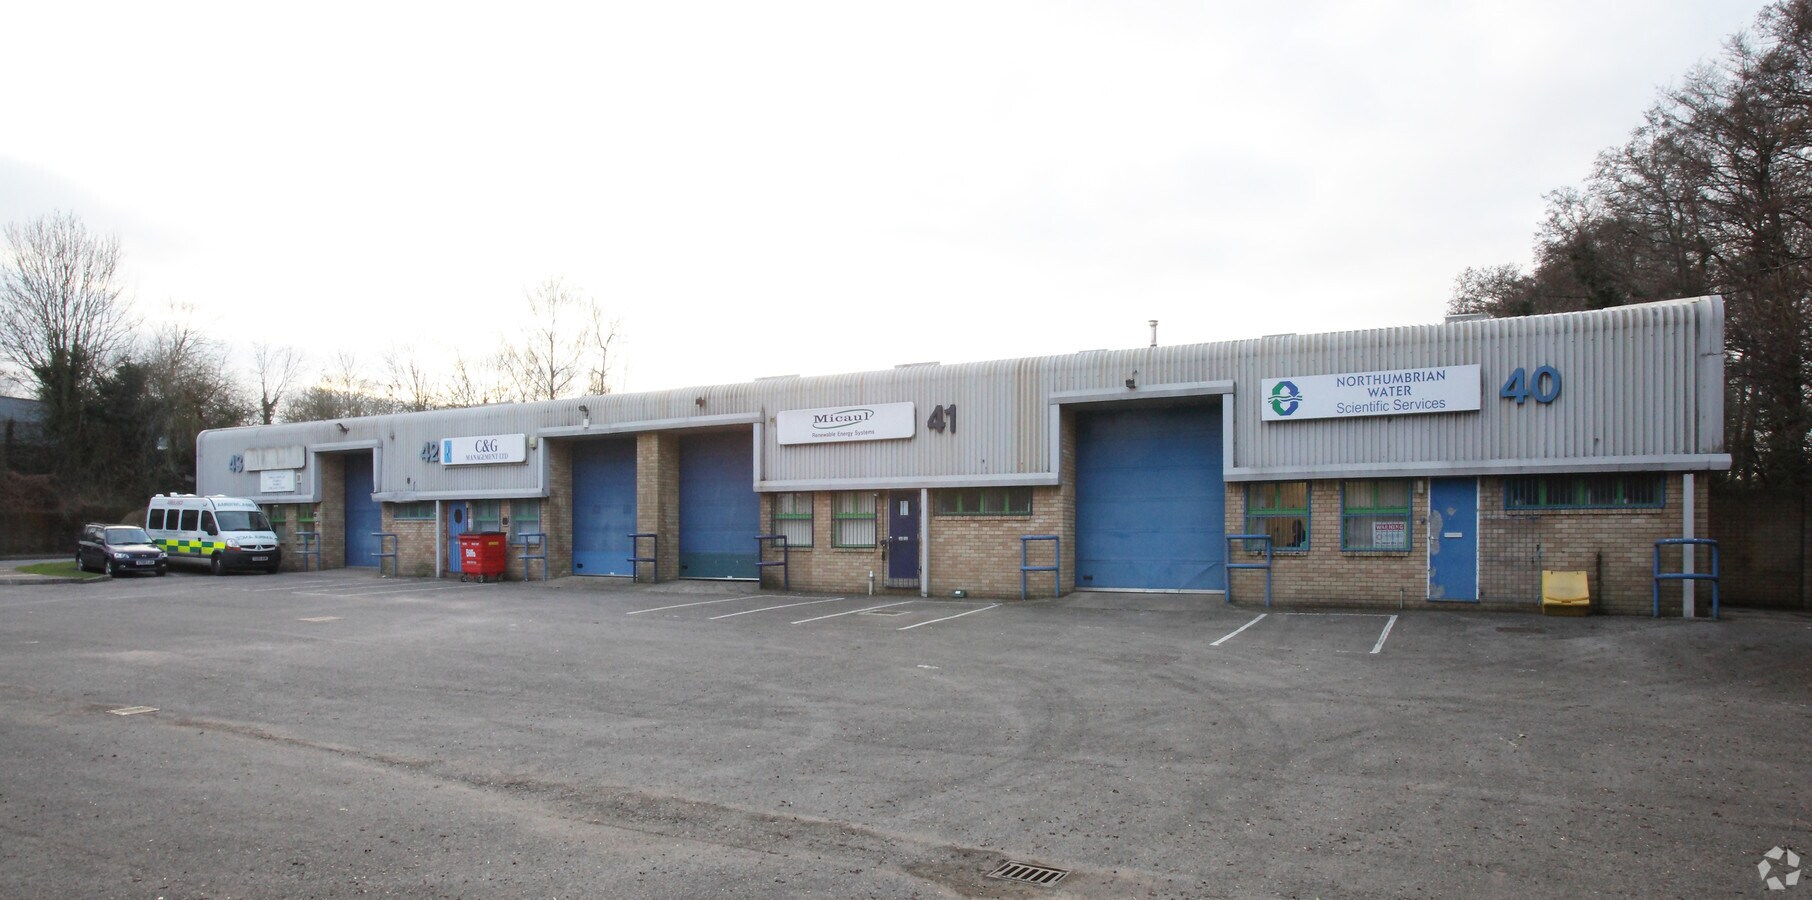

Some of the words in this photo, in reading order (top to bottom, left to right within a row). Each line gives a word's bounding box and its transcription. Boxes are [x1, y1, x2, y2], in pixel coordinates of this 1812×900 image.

[1337, 370, 1446, 387] NORTHUMBRIAN
[1501, 366, 1561, 404] 40
[1367, 385, 1412, 398] WATER
[1337, 400, 1390, 414] Scientific
[1394, 398, 1446, 411] Services
[813, 412, 869, 423] Micaul
[927, 404, 956, 433] 41
[837, 430, 853, 438] Energy
[854, 429, 875, 437] Systems
[422, 442, 440, 463] 42
[475, 439, 498, 453] C&G
[229, 454, 244, 473] 43
[465, 453, 498, 461] MANAGEMENT
